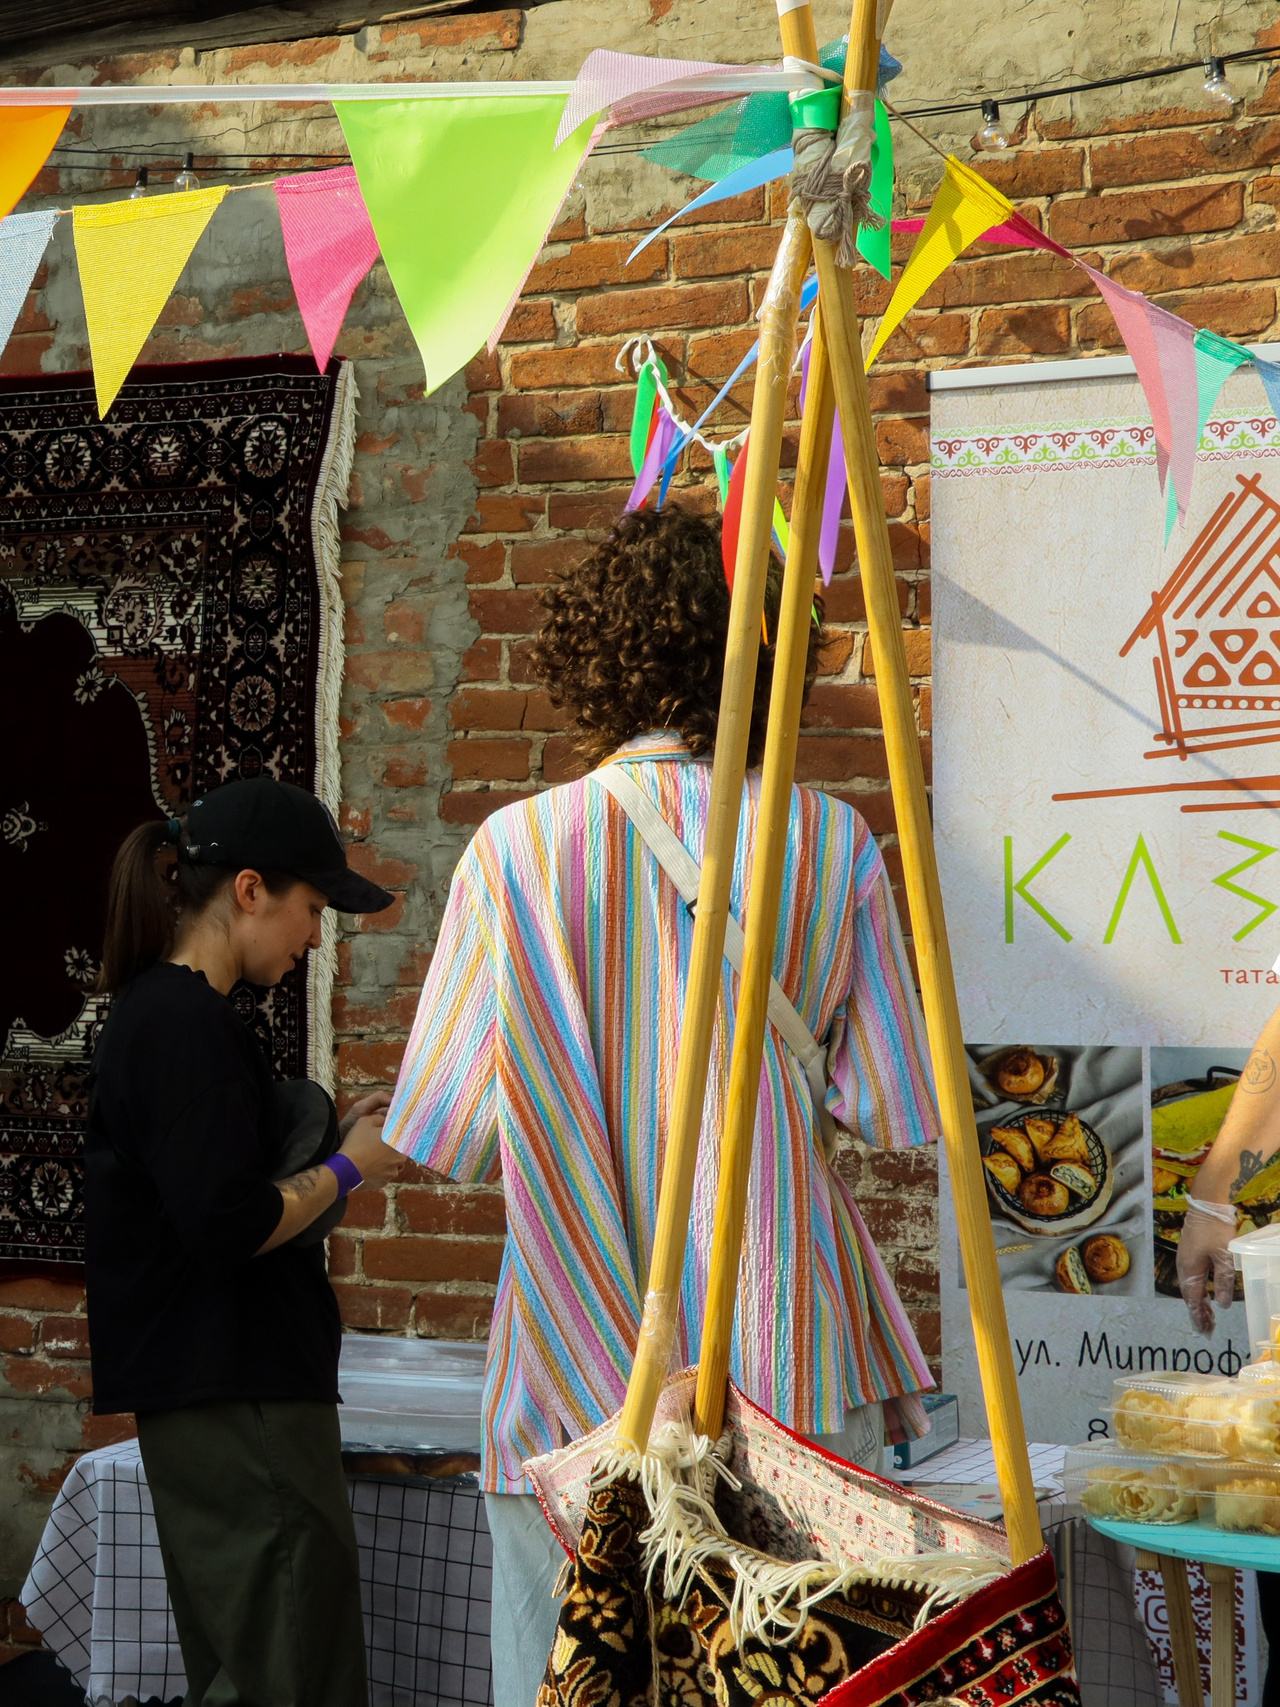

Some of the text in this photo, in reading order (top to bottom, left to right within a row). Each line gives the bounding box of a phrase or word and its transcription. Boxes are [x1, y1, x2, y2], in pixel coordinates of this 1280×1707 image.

[1219, 969, 1280, 984] тата
[1014, 1330, 1252, 1377] ул. Митроф
